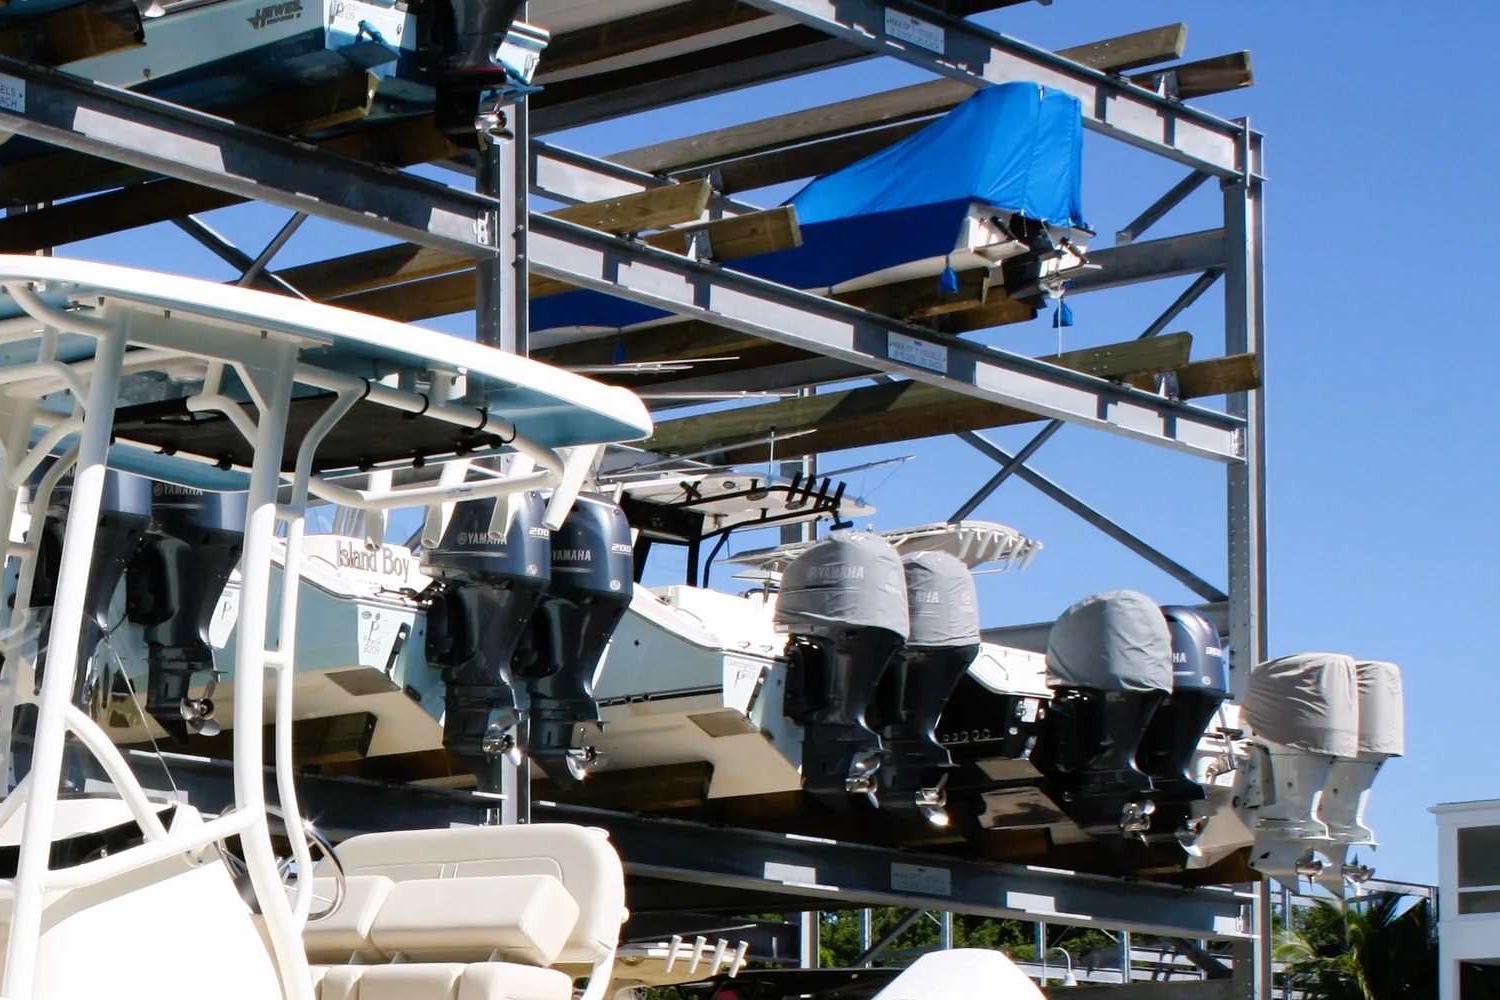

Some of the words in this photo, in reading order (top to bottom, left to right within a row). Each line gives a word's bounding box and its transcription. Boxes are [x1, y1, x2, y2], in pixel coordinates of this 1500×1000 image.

[528, 526, 550, 538] 200
[611, 543, 632, 554] 200
[336, 539, 378, 573] Island
[382, 546, 410, 583] Boy
[552, 550, 592, 562] YAMAHA
[818, 566, 865, 580] YAMAHA
